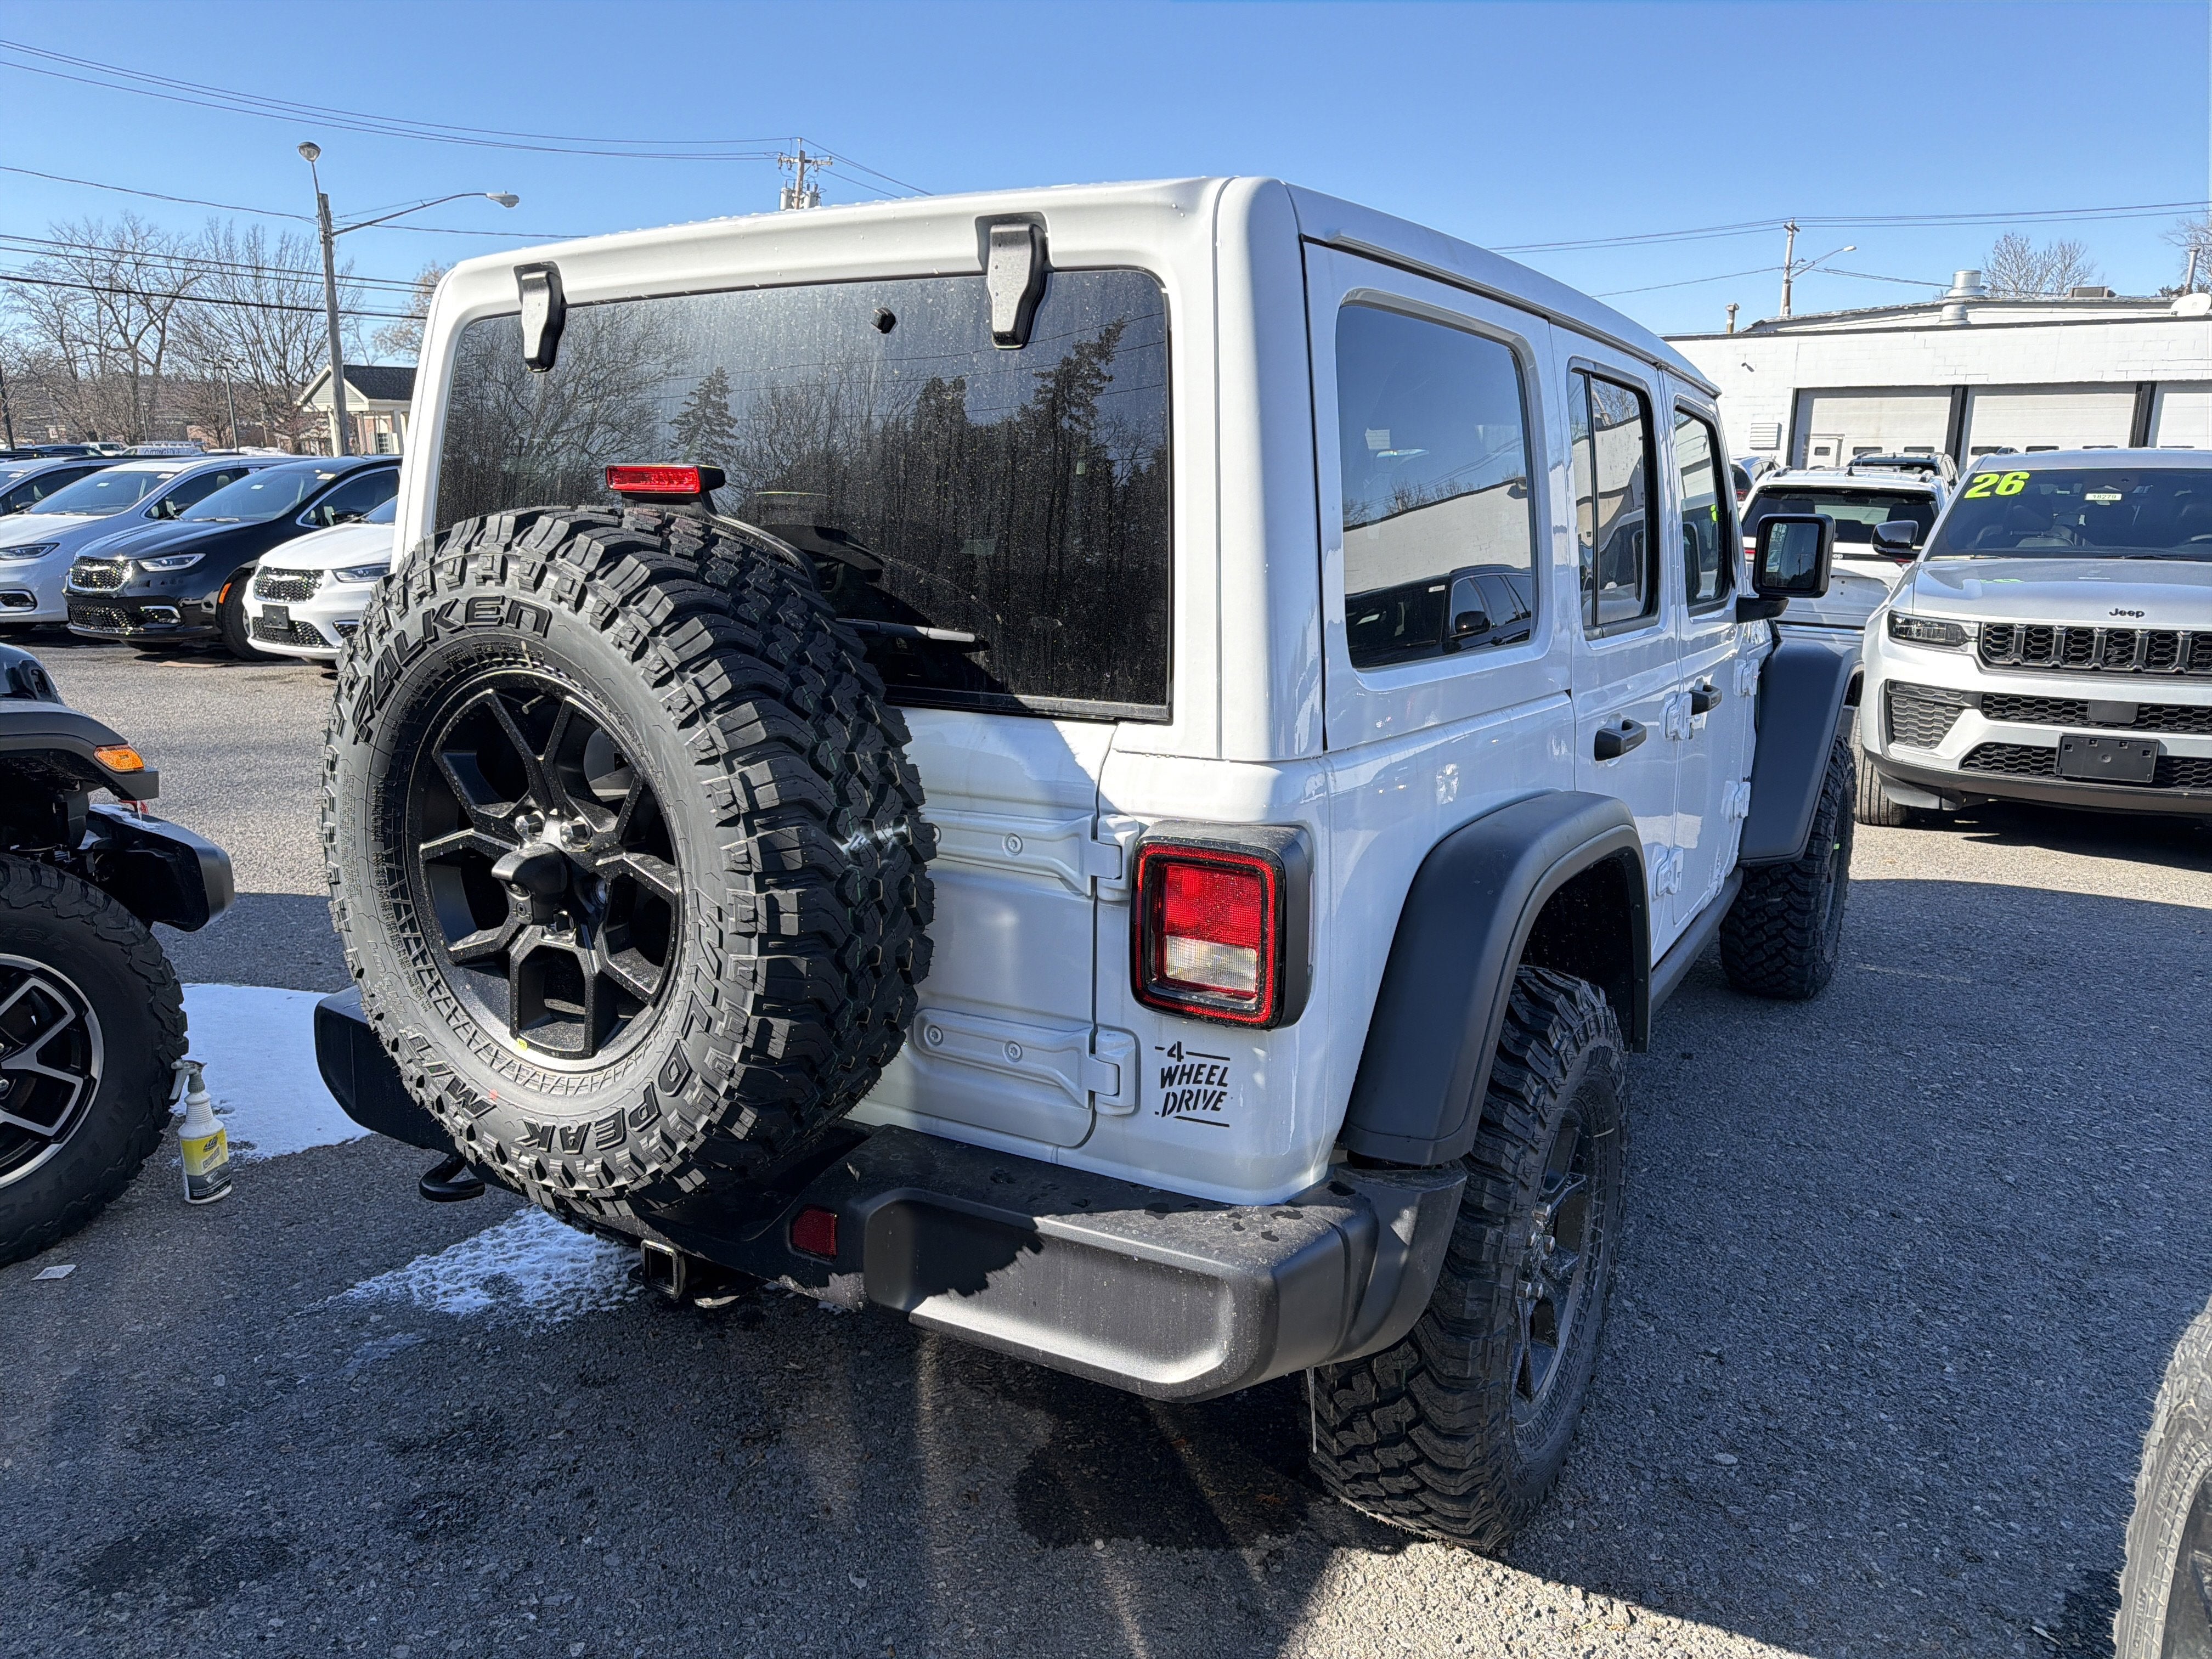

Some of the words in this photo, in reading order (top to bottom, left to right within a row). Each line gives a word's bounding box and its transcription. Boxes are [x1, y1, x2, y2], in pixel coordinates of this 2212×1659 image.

[1964, 471, 2030, 499] 26
[2109, 608, 2145, 618] Jeep
[352, 594, 553, 746] FALKEN
[1167, 1041, 1184, 1062] 4
[1160, 1064, 1228, 1089] WHEEL
[1161, 1088, 1227, 1118] DRIVE
